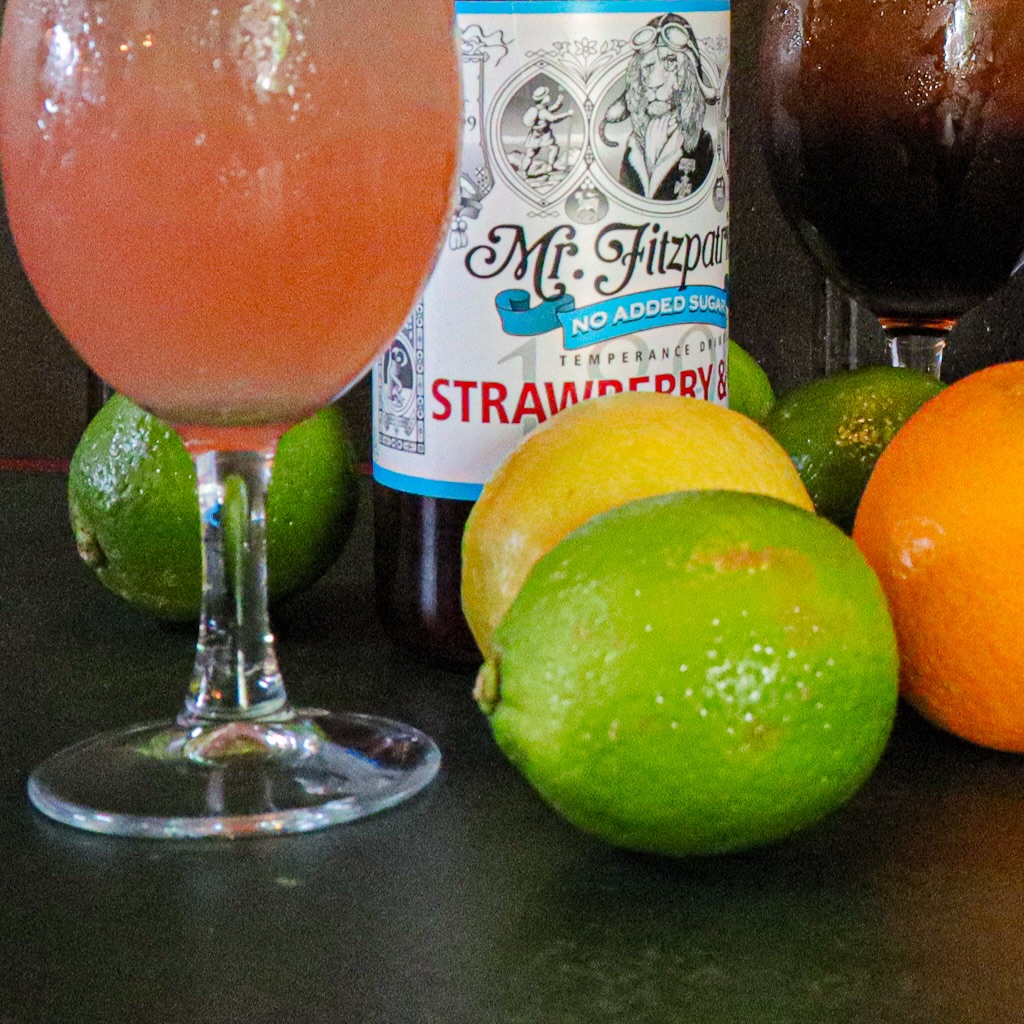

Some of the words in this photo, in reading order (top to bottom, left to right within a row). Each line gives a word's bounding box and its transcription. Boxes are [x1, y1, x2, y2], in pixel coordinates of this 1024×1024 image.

[465, 224, 584, 301] Mr.
[572, 311, 608, 335] NO
[612, 295, 686, 325] ADDED
[559, 344, 690, 367] TEMPERANCE
